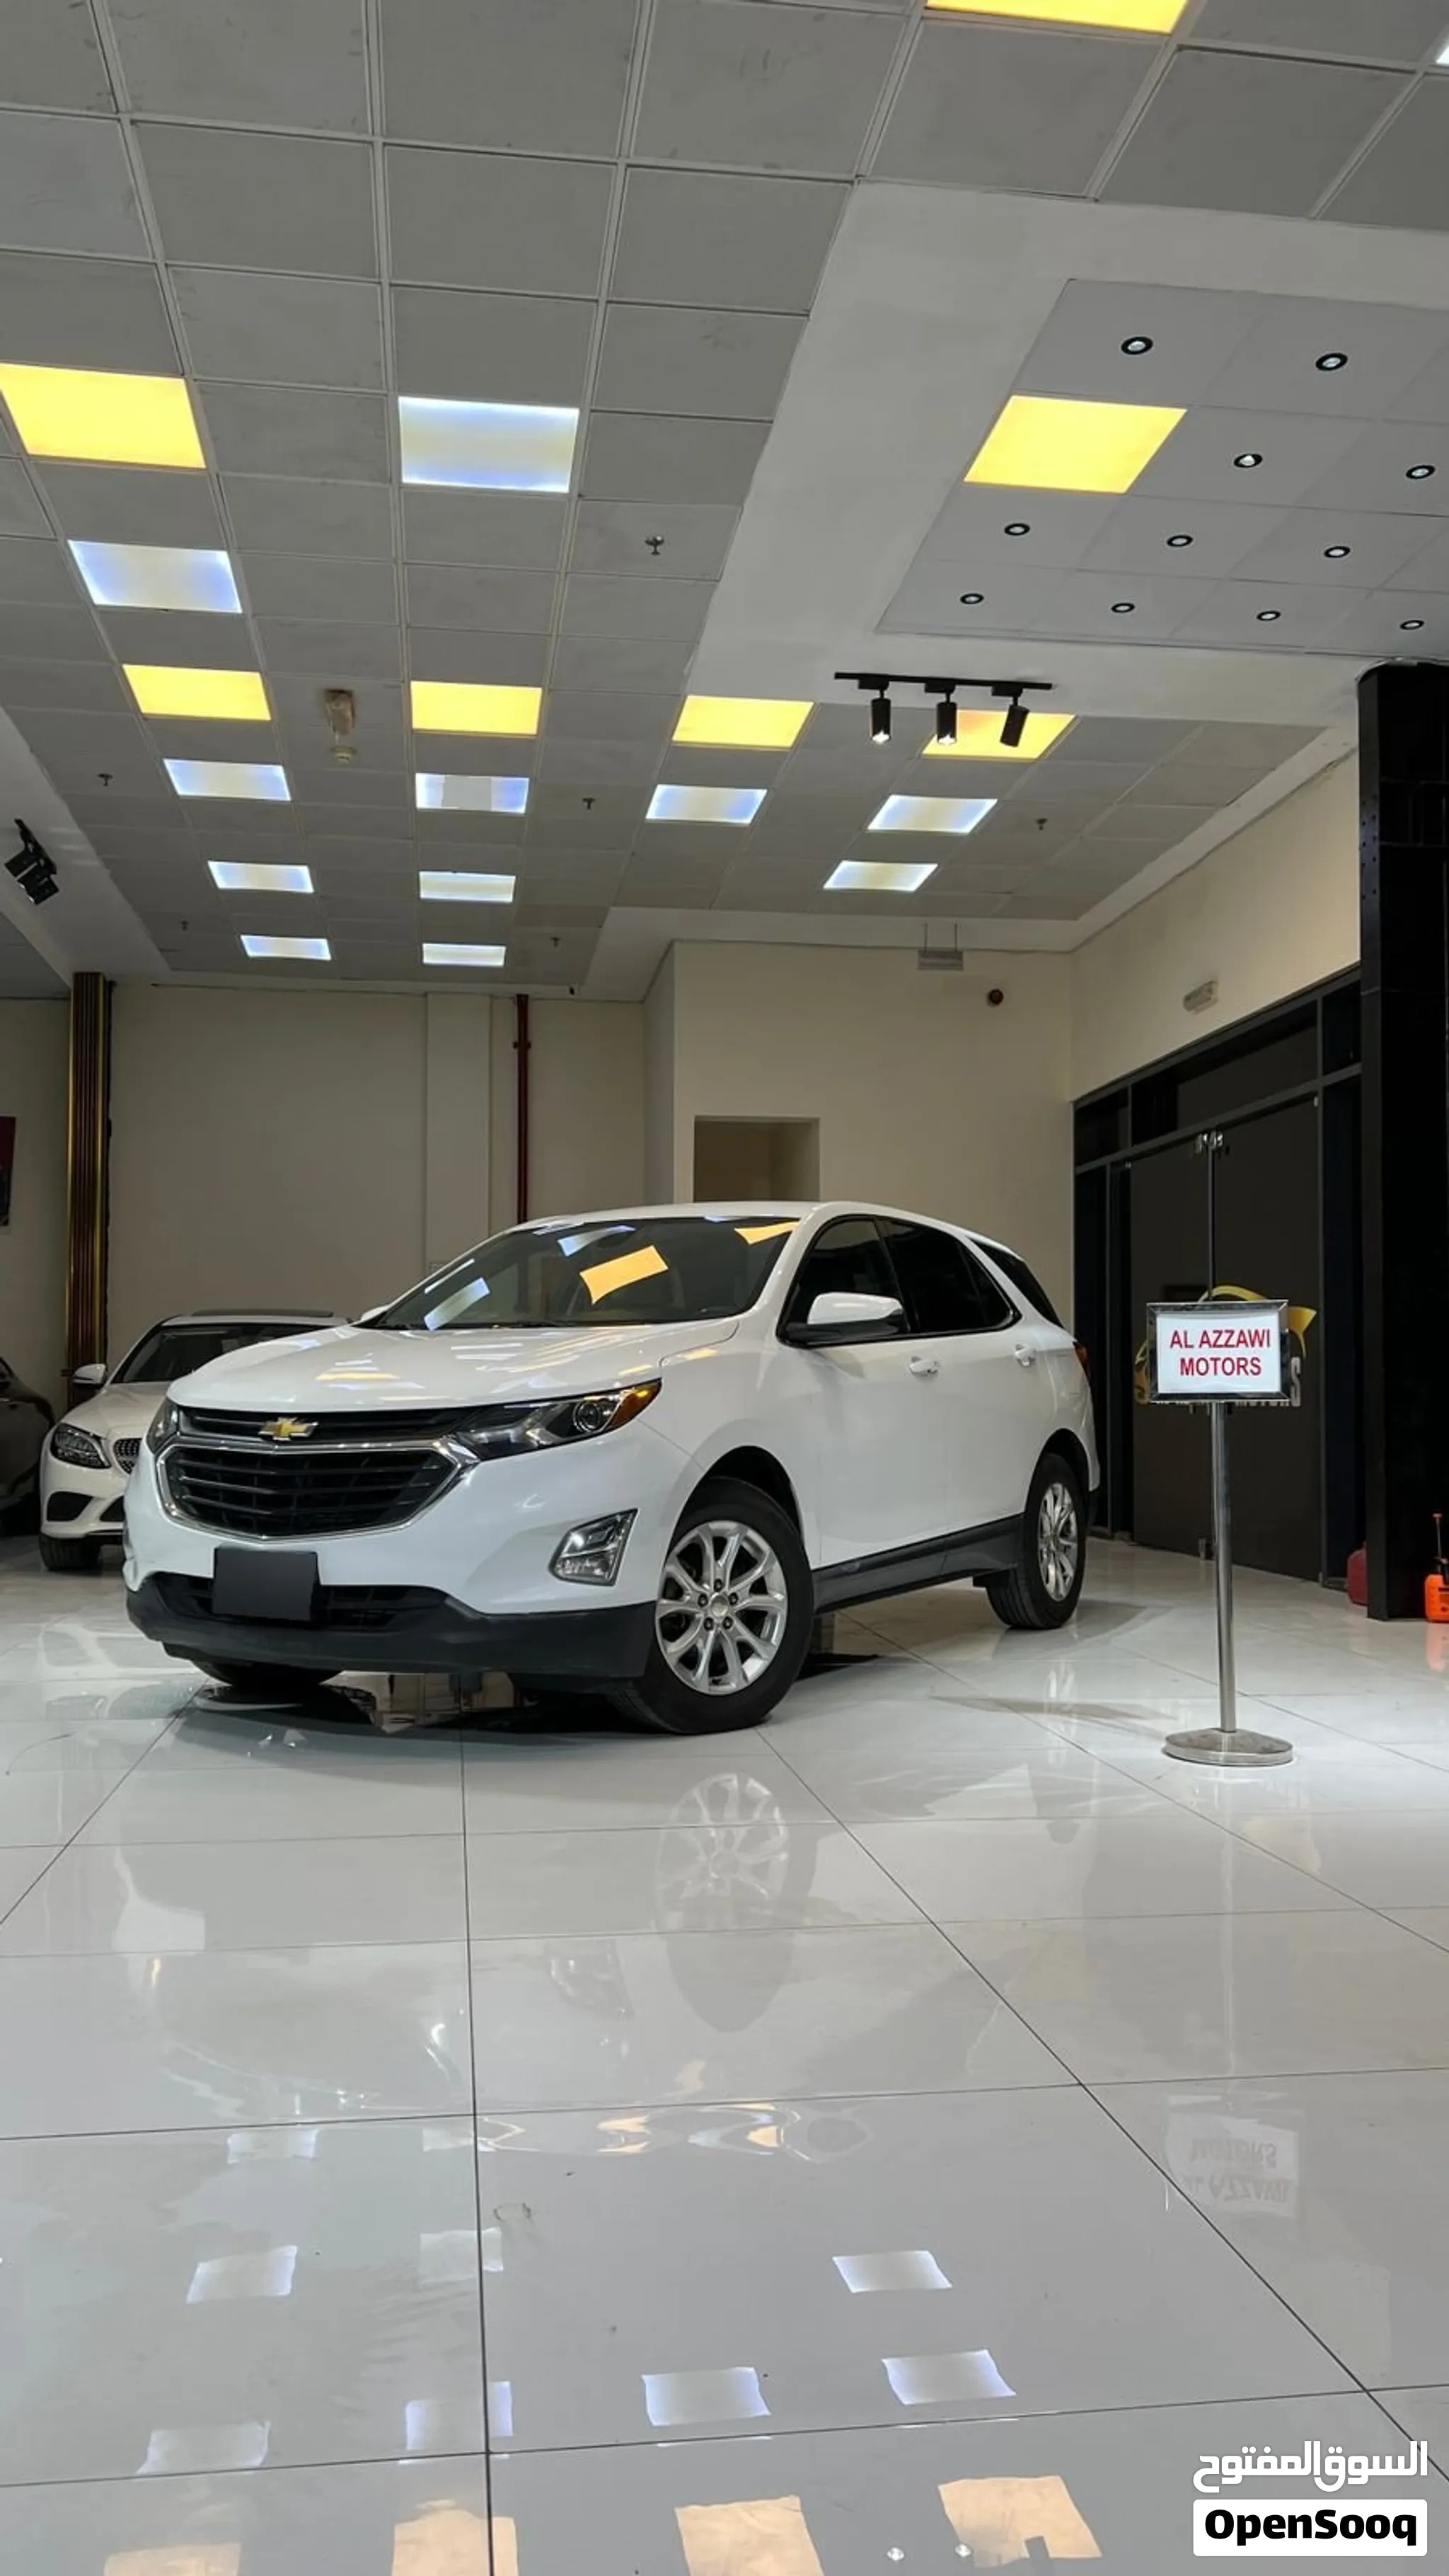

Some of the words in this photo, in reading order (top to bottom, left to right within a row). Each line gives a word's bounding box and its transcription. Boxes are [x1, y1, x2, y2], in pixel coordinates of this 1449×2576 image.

[1170, 1330, 1194, 1348] AL
[1199, 1329, 1271, 1348] AZZAWI
[1179, 1357, 1262, 1376] MOTORS
